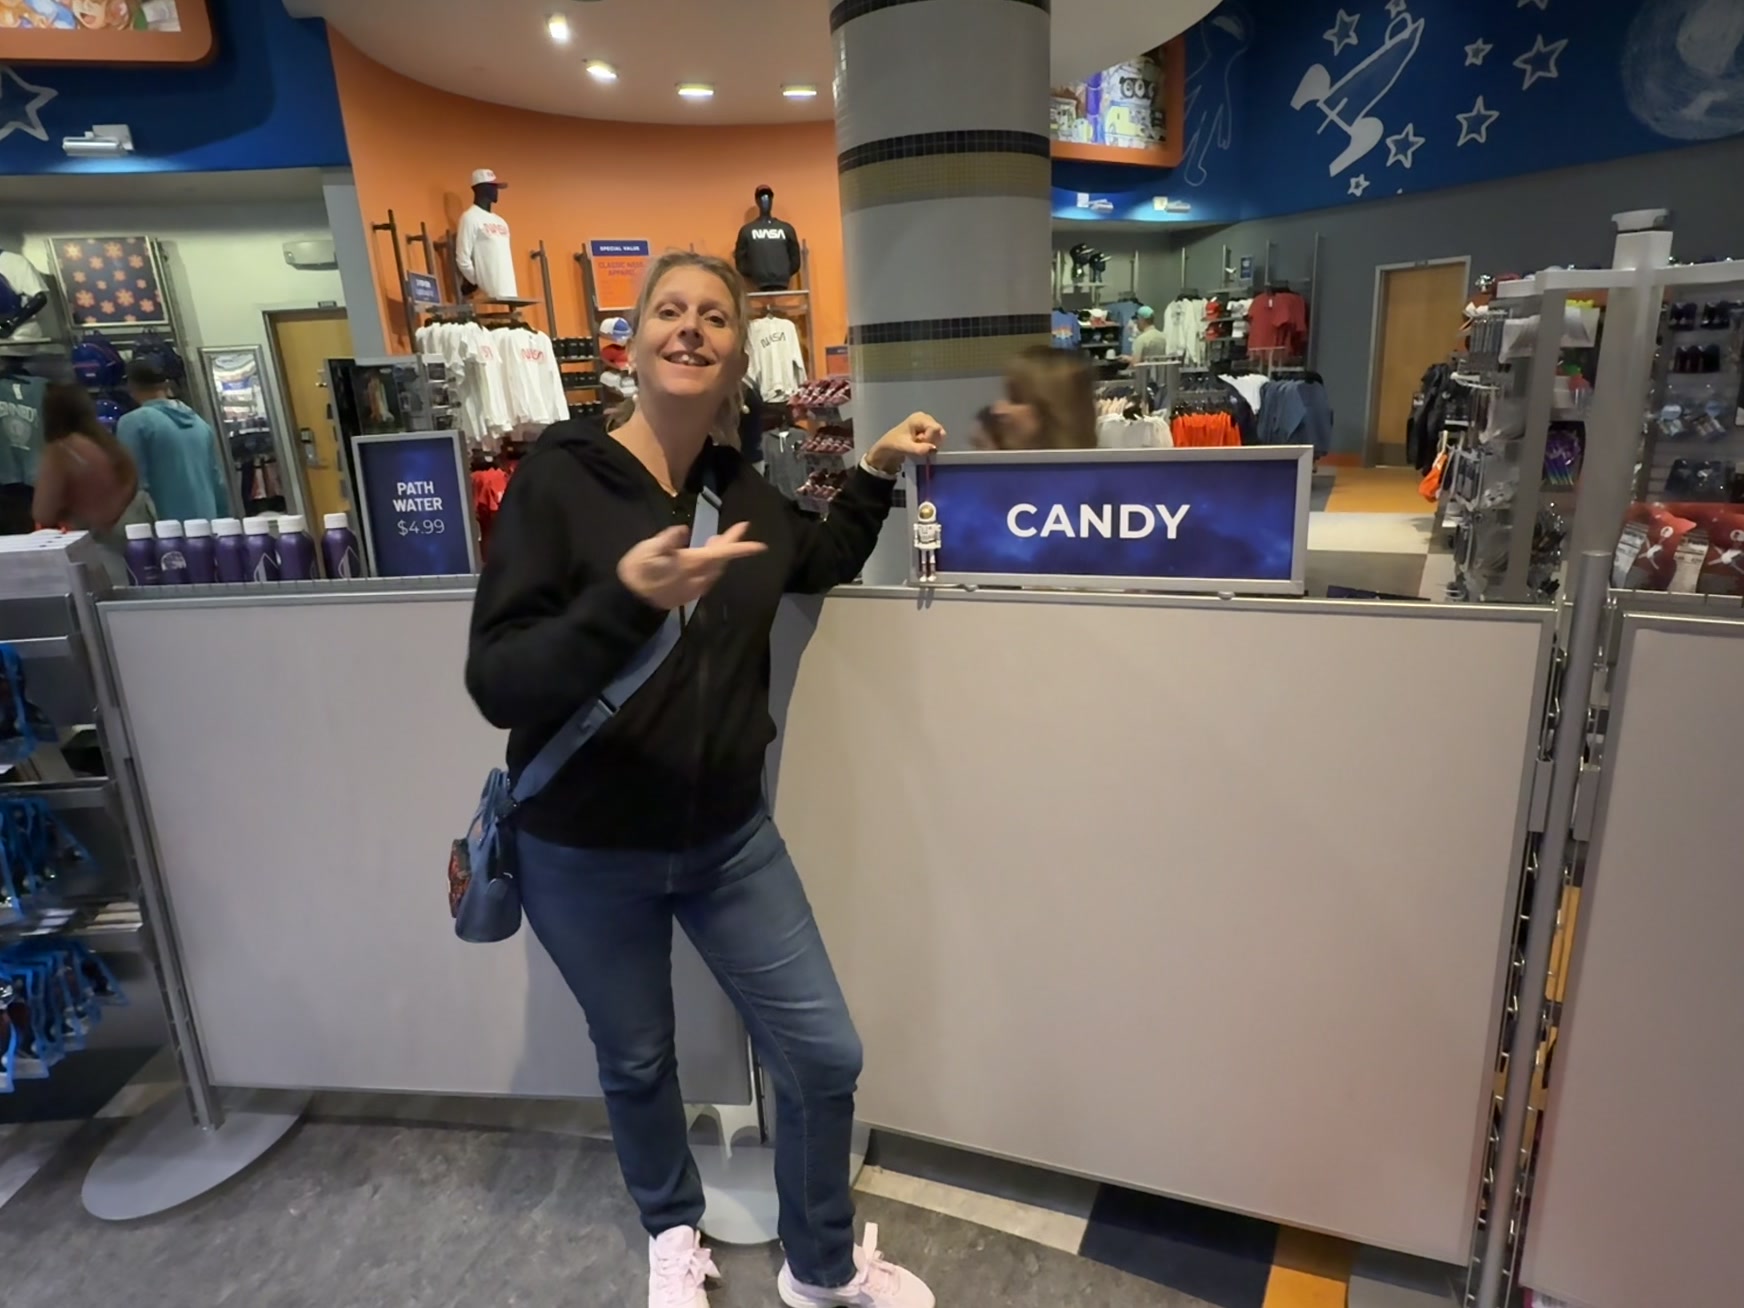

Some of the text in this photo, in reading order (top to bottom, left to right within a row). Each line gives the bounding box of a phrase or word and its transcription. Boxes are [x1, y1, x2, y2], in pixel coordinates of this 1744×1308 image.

[751, 228, 786, 240] NASA
[759, 331, 787, 349] NASA
[396, 480, 435, 496] PATH
[392, 497, 443, 512] WATER
[397, 518, 445, 537] $4.99
[1006, 502, 1191, 540] CANDY
